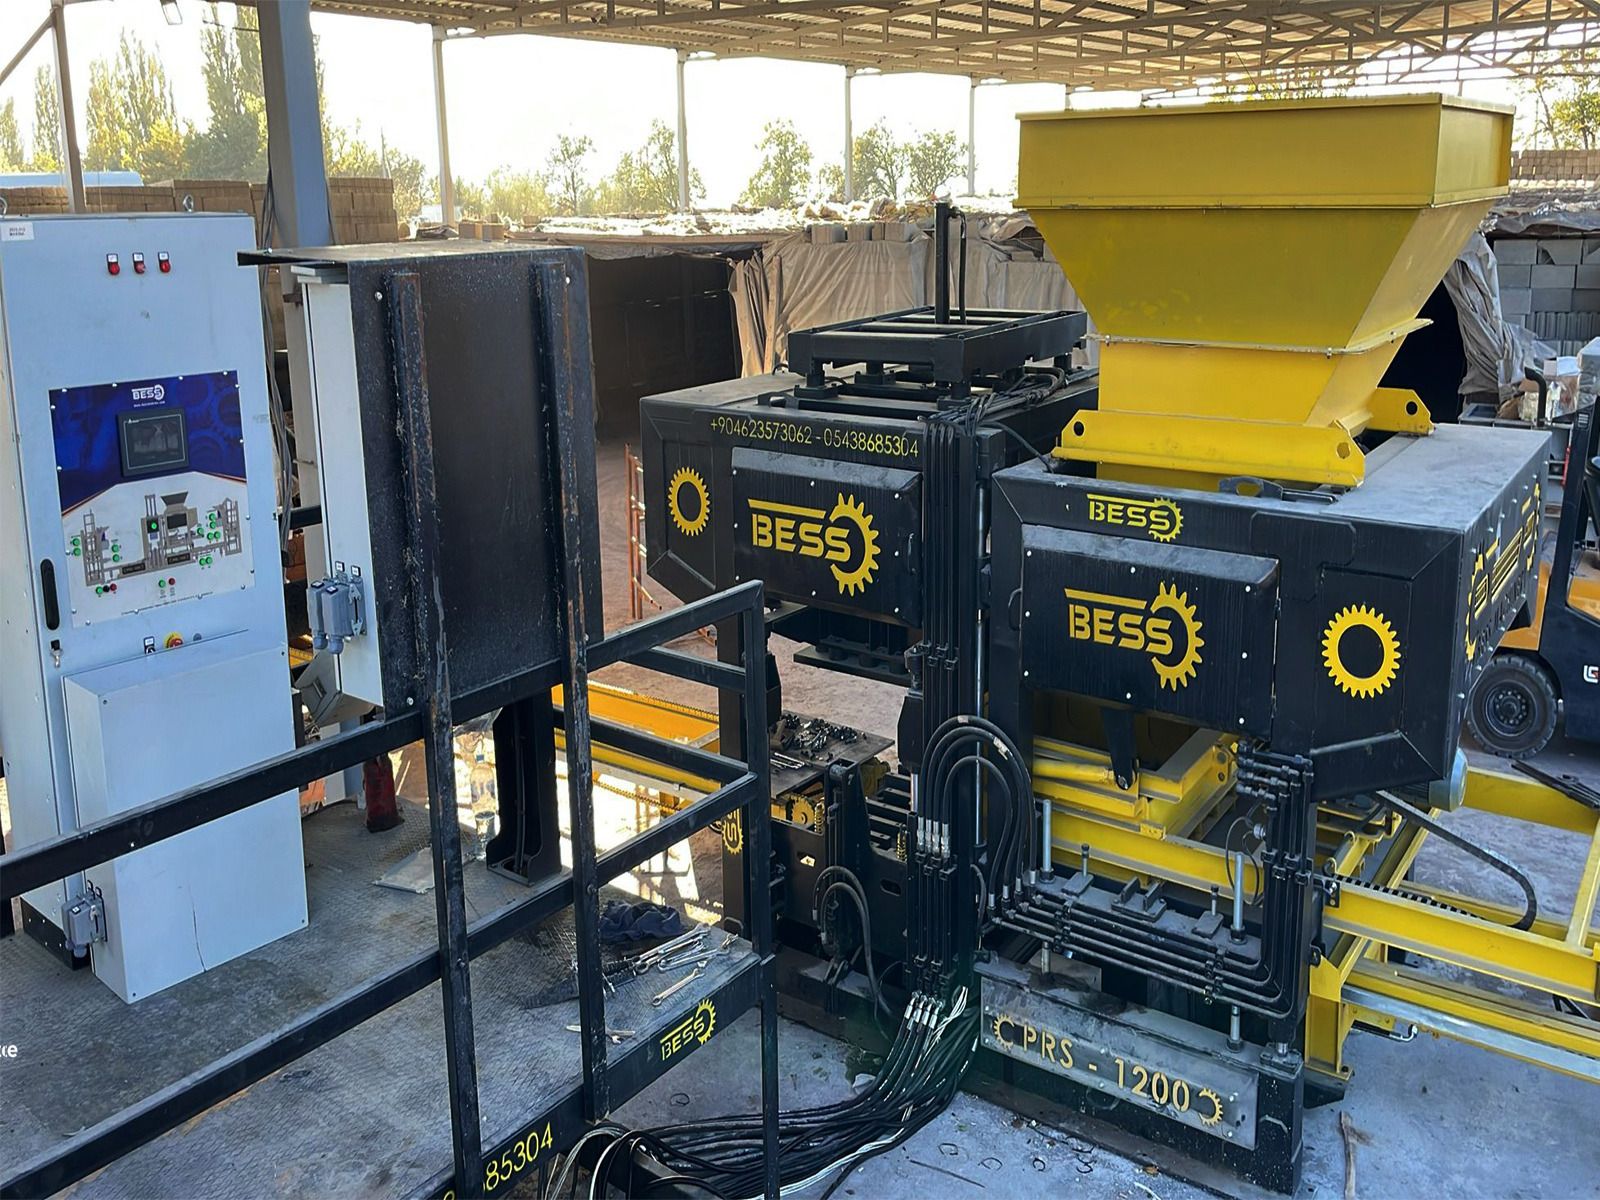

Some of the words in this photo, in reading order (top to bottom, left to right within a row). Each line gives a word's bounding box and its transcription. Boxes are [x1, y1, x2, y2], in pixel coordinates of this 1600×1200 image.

[132, 385, 162, 400] BESS
[711, 416, 812, 445] +904623573062
[823, 427, 919, 458] 05438685304
[751, 512, 852, 562] BESS
[1088, 500, 1171, 531] BESS
[1068, 603, 1174, 655] BESS
[661, 1014, 706, 1061] BESS
[1023, 1021, 1074, 1070] PRS
[1114, 1056, 1191, 1112] 1200
